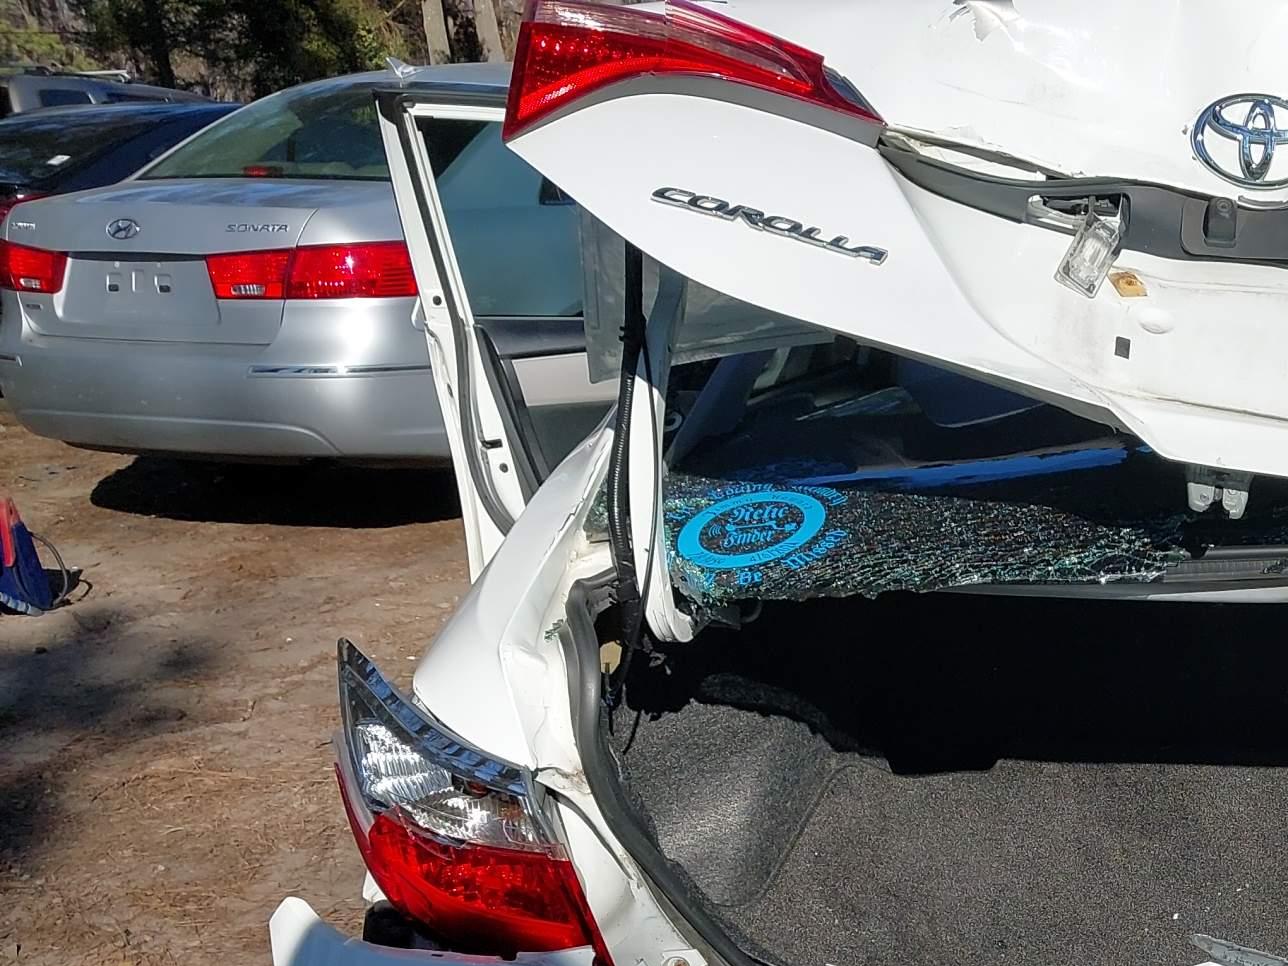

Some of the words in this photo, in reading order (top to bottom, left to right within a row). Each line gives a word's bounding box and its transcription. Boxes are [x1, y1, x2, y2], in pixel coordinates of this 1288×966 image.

[225, 223, 289, 233] SONATA
[650, 187, 889, 267] COROLLA
[707, 480, 774, 500] Loving
[727, 504, 790, 523] Relic
[722, 530, 774, 548] Finder
[780, 528, 849, 570] Missed
